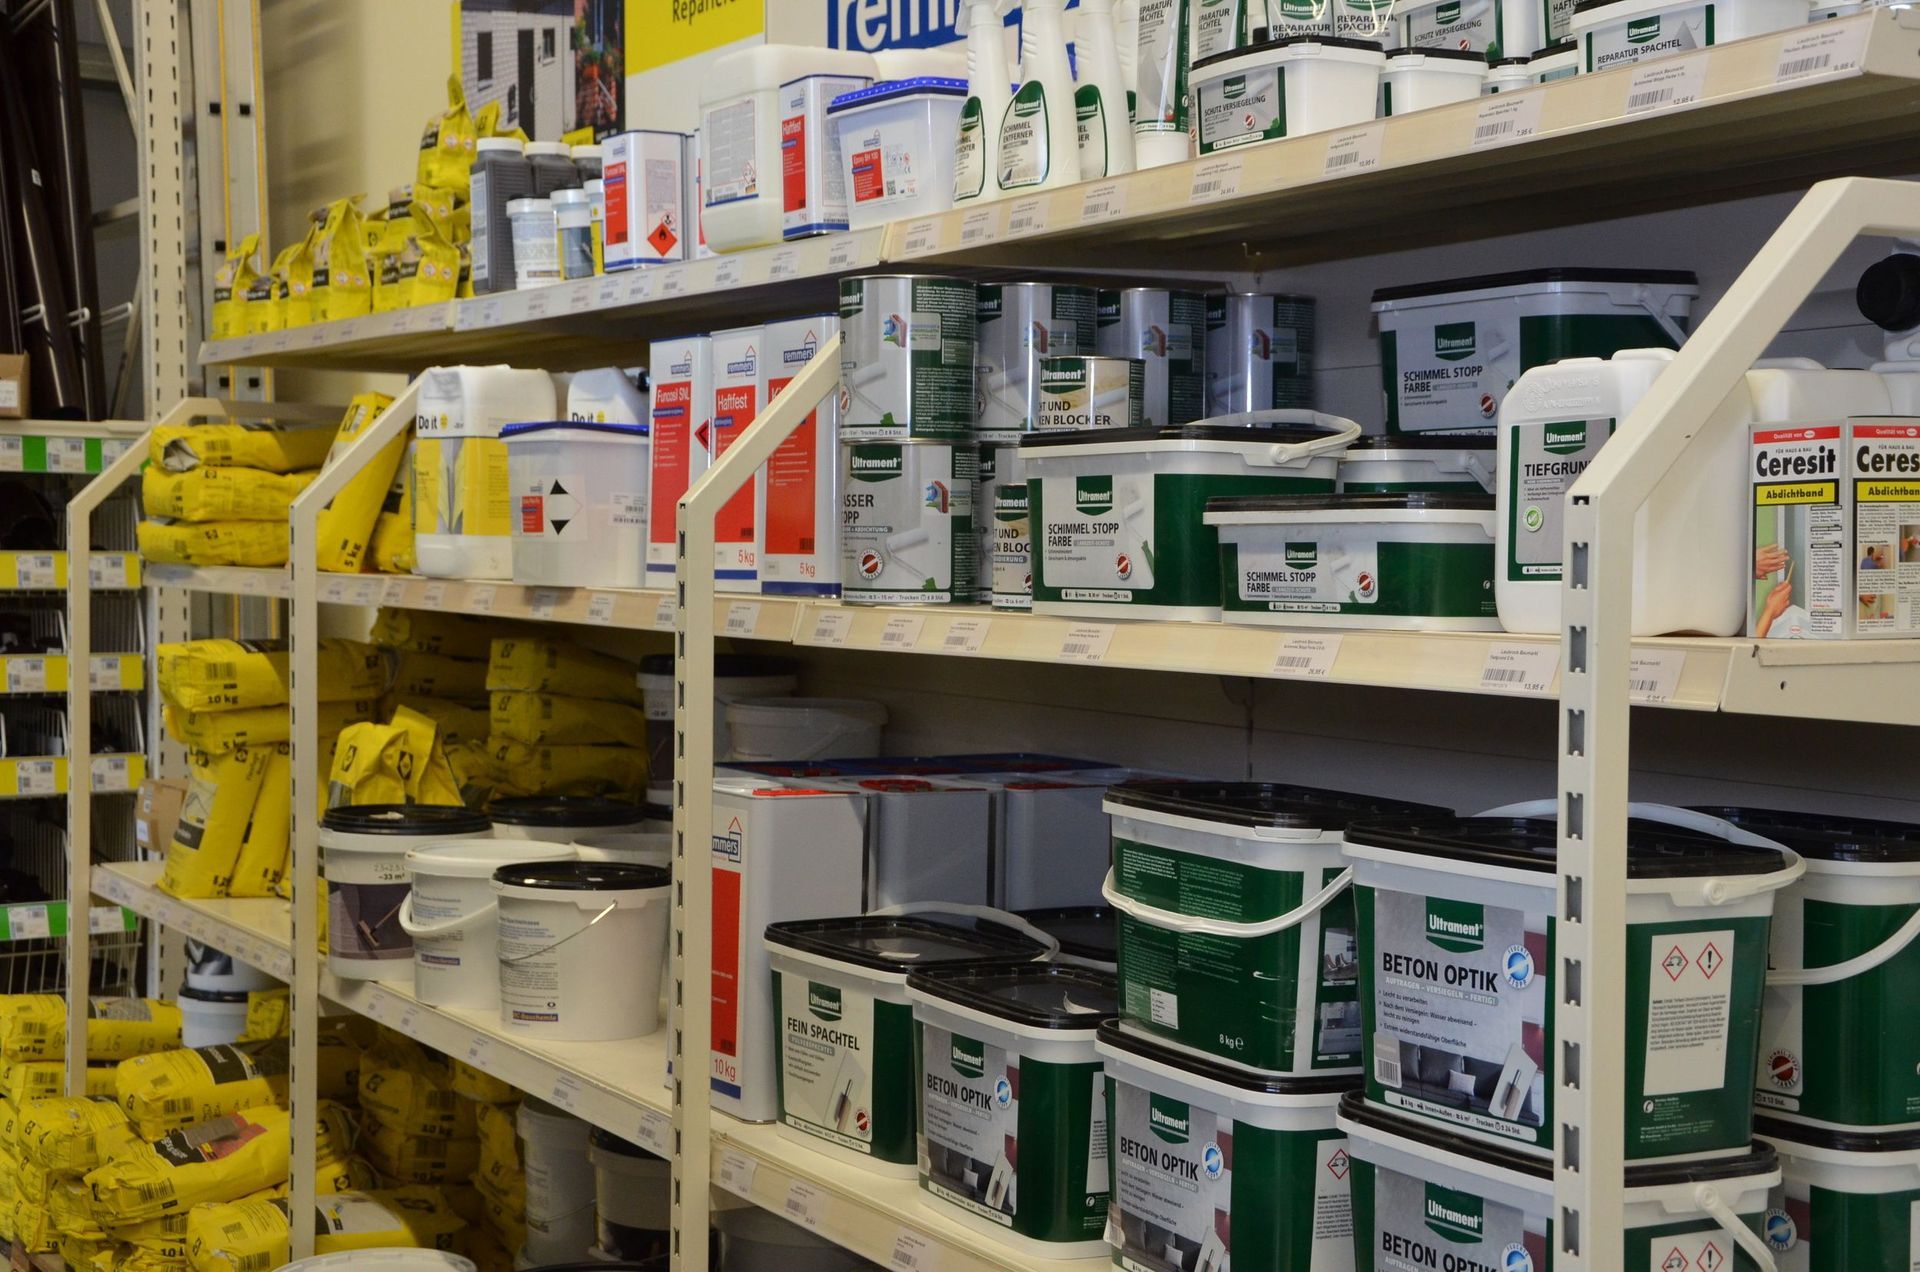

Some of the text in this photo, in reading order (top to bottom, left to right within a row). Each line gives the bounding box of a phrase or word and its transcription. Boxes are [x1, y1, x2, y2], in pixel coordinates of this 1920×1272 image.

[1414, 20, 1482, 43] SCHUTZ VERSIEGELUNG
[1629, 22, 1659, 37] Ultrament
[1597, 38, 1682, 65] REPARATUR SPACHTEL
[1204, 94, 1267, 117] SCHUTZ VERSIEGELUNG
[1003, 121, 1031, 135] SCHIMMEL
[1003, 129, 1034, 144] ENTFERNER
[1436, 337, 1474, 349] Ultrament
[784, 349, 814, 362] remmers
[728, 361, 754, 374] remmers
[1403, 365, 1483, 382] SCHIMMEL STOPP
[1404, 381, 1431, 393] FARBE
[717, 393, 748, 412] Haftfest
[1048, 401, 1070, 412] UND
[418, 415, 437, 430] Do it
[1053, 414, 1111, 427] BLOCKER
[1546, 431, 1585, 444] Ultrament
[1794, 431, 1803, 439] von
[851, 456, 901, 469] Ultrament
[1524, 460, 1592, 477] TIEFGRUN
[1756, 445, 1836, 477] Ceresit
[1078, 490, 1110, 502] Ultrament
[1766, 487, 1824, 499] Abdichtband
[998, 528, 1019, 539] UND
[1048, 522, 1119, 535] SCHIMMEL STOPP
[1048, 535, 1072, 547] FARBE
[738, 549, 755, 567] 5 kg
[1286, 550, 1315, 560] Ultrament
[799, 562, 816, 578] 5 kg
[1246, 571, 1316, 583] SCHIMMEL STOPP
[1247, 582, 1271, 593] FARBE
[1523, 683, 1540, 691] 13,95
[208, 693, 238, 705] 10 kg
[1428, 914, 1483, 937] Ultrament
[1383, 952, 1499, 993] BETON OPTIK
[1385, 976, 1420, 990] AUFTRAGEN
[1426, 984, 1464, 999] VERSIEGELN
[1383, 1001, 1394, 1009] Nach
[787, 1017, 860, 1051] FEIN SPACHTEL
[1219, 1033, 1235, 1050] 8 kg
[1440, 1036, 1467, 1047] Oberfläche
[952, 1046, 984, 1067] Ultrament
[714, 1057, 736, 1082] 10 kg
[927, 1072, 993, 1112] BETON OPTIK
[1151, 1107, 1187, 1131] Ultrament
[1475, 1118, 1495, 1128] Trocken
[1120, 1136, 1199, 1182] BETON OPTIK
[1428, 1199, 1483, 1229] Ultrament
[1383, 1231, 1438, 1269] BETON
